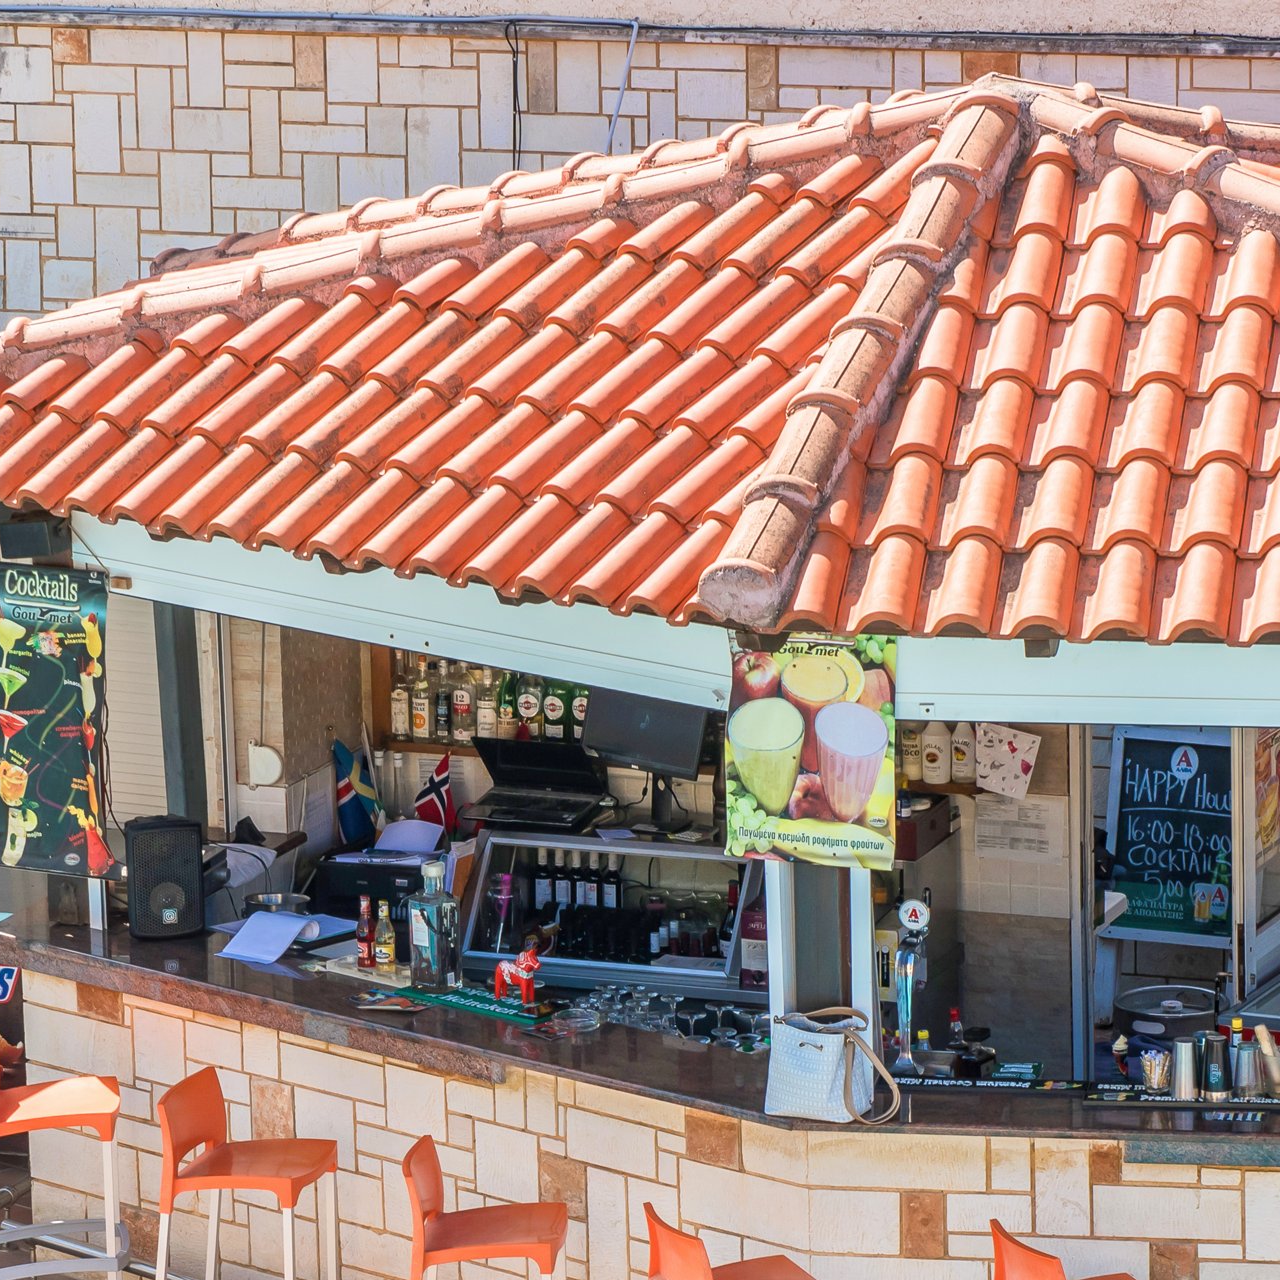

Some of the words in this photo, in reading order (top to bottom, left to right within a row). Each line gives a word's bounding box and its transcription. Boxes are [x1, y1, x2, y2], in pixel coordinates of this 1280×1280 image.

[4, 569, 78, 602] Cocktails
[454, 693, 465, 703] 12
[738, 827, 777, 841] Παγωμένα
[777, 832, 811, 846] κρεμώδη
[850, 836, 885, 851] φρούτων
[441, 994, 521, 1015] Heineken
